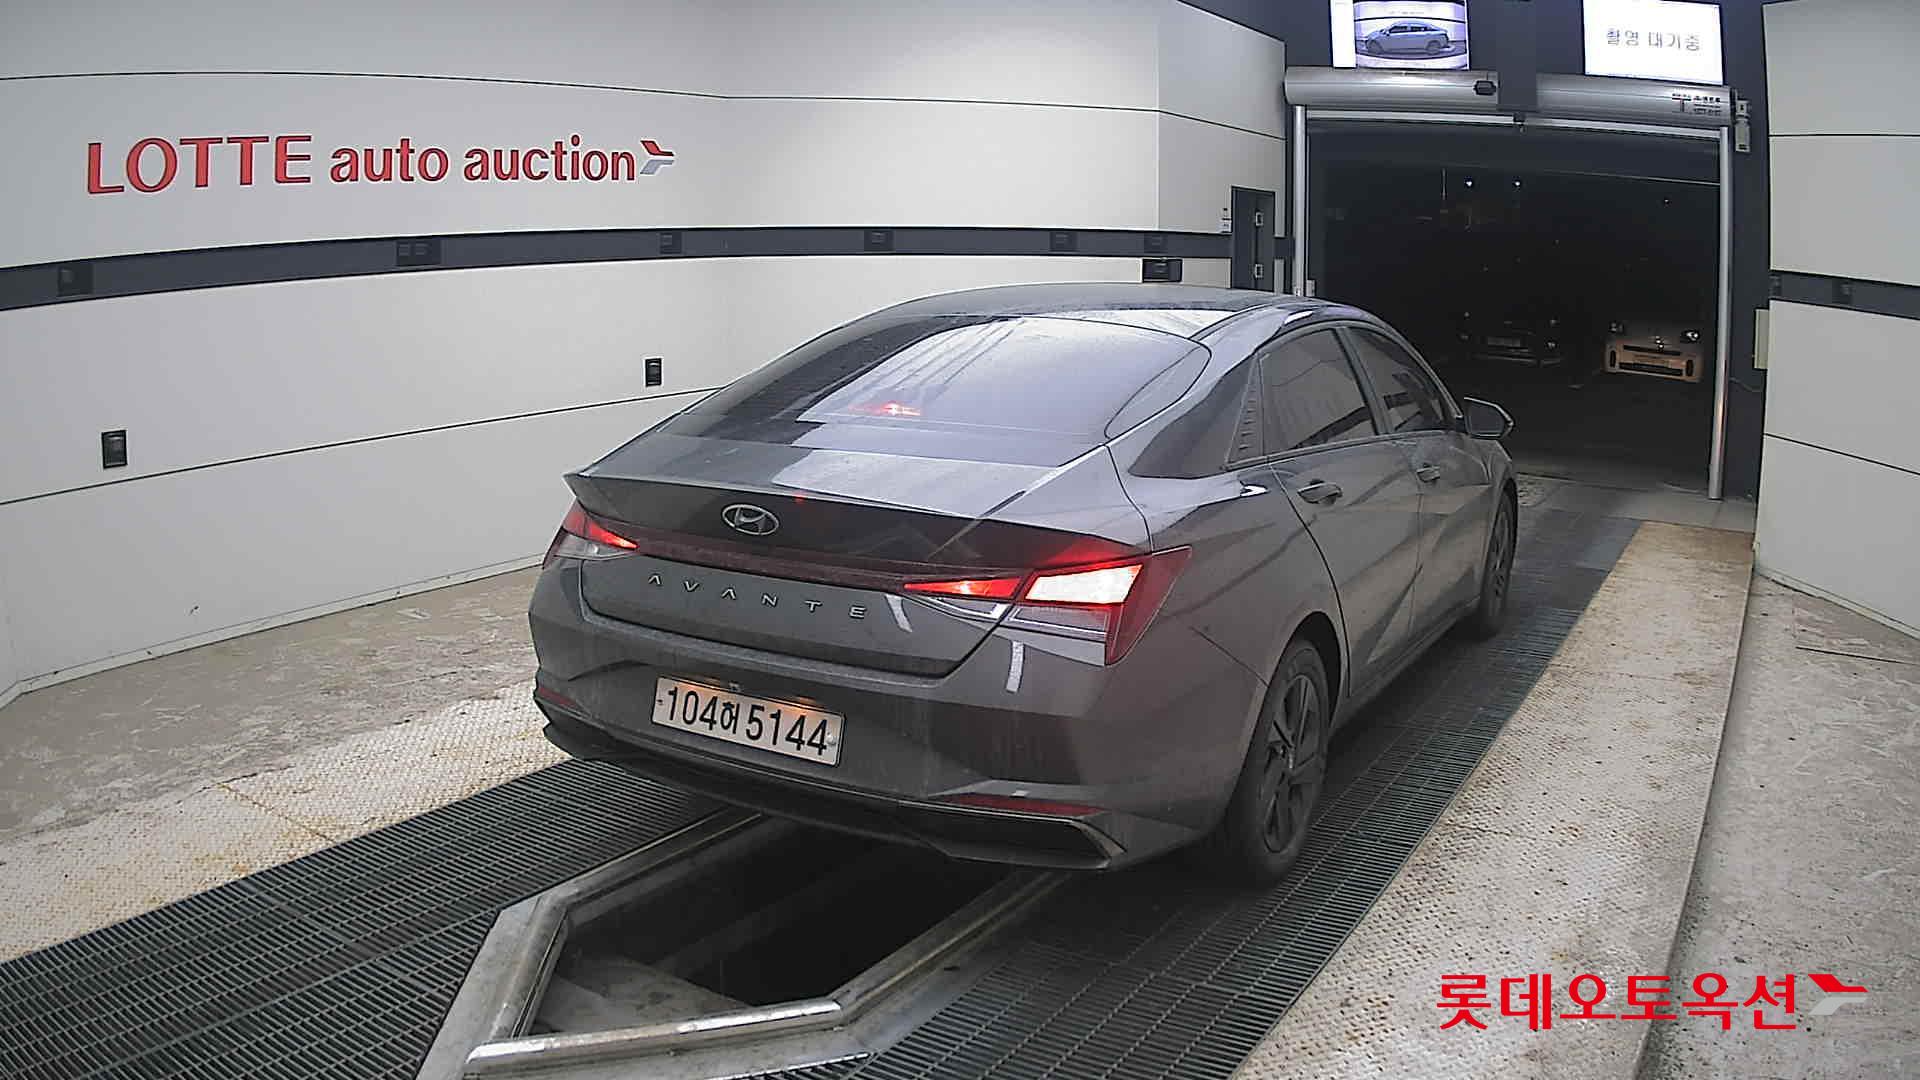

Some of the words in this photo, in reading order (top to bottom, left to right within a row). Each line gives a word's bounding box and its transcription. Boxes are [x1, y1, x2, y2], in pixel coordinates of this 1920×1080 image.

[87, 135, 312, 195] LOTTE
[329, 138, 449, 182] auto
[463, 134, 636, 181] auction
[648, 573, 867, 619] AVANTE
